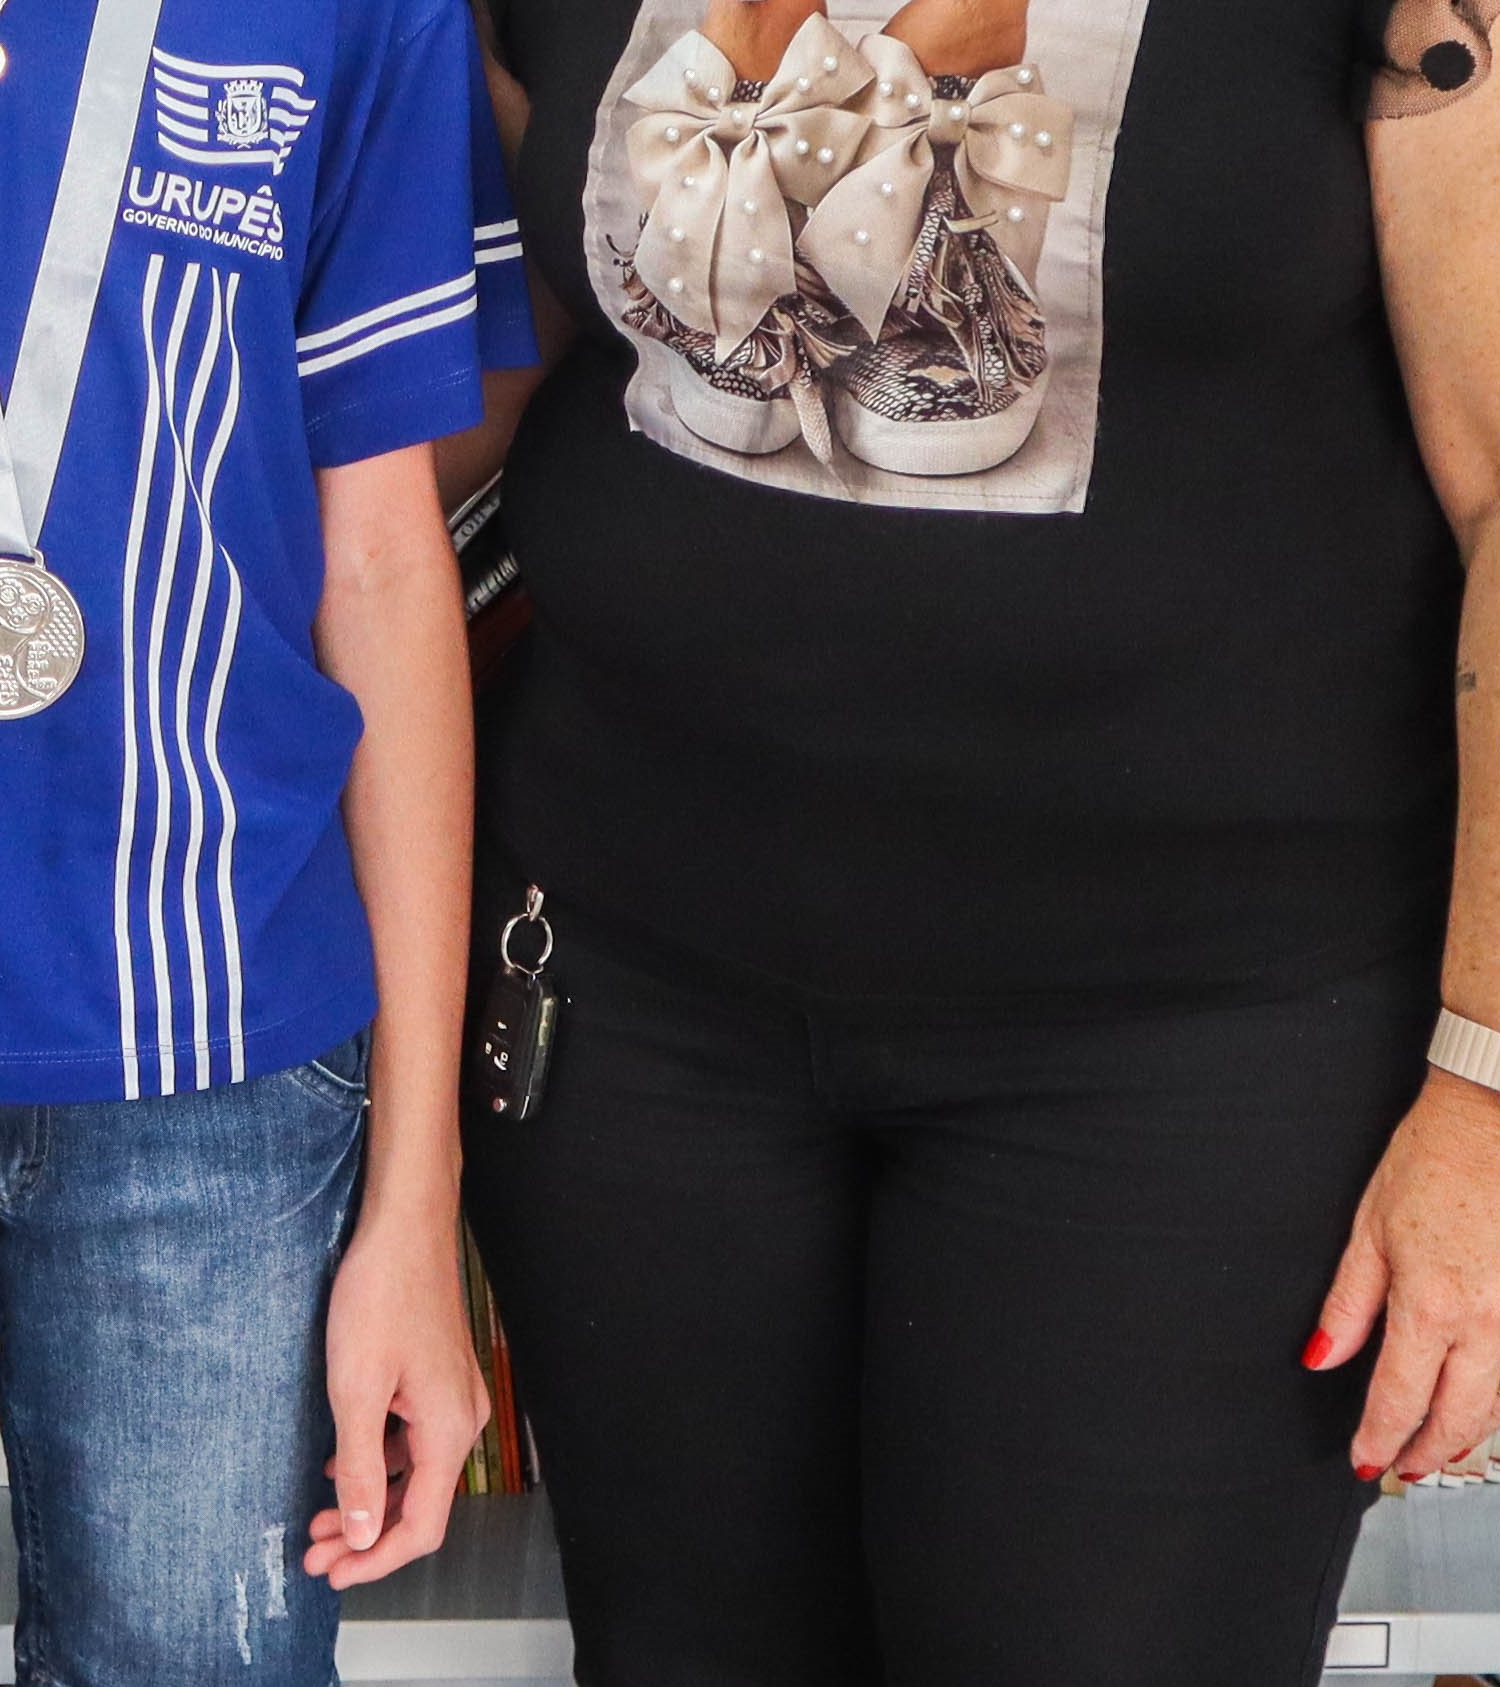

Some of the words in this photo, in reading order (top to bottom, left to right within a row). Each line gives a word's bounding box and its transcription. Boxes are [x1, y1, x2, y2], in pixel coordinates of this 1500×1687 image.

[122, 208, 199, 236] GOVERNO
[213, 230, 285, 261] MUNICÍPIO
[127, 166, 284, 243] URUPÊS
